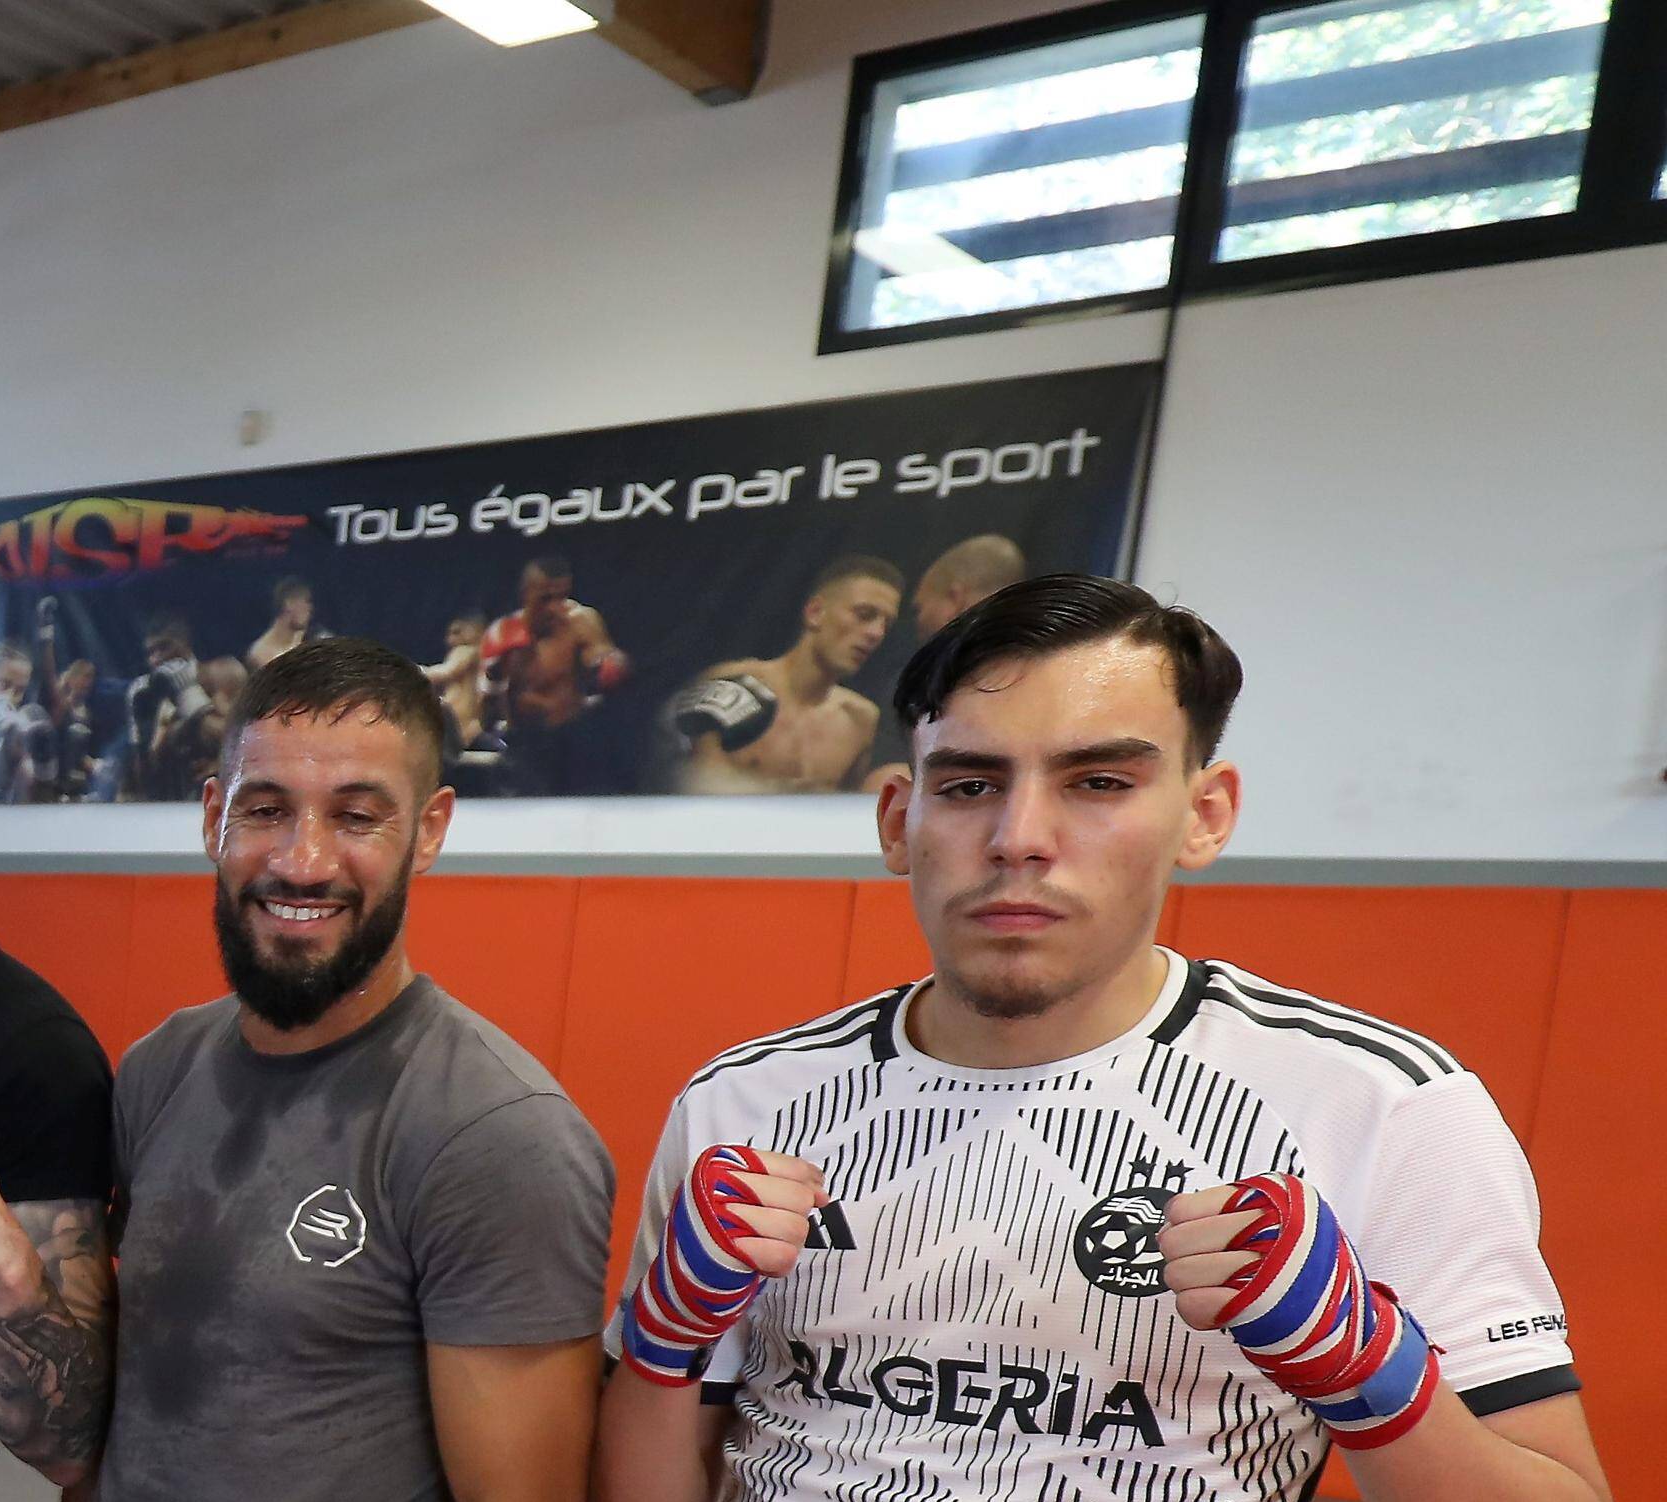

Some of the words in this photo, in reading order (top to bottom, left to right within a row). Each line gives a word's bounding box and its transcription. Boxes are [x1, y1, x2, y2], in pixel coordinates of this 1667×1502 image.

[326, 503, 459, 545] Tous
[469, 483, 677, 537] égaux
[685, 465, 805, 521] par
[818, 453, 881, 499] le
[894, 428, 1101, 498] sport
[1487, 1320, 1529, 1342] LES
[774, 1338, 1165, 1447] ALGERIA
